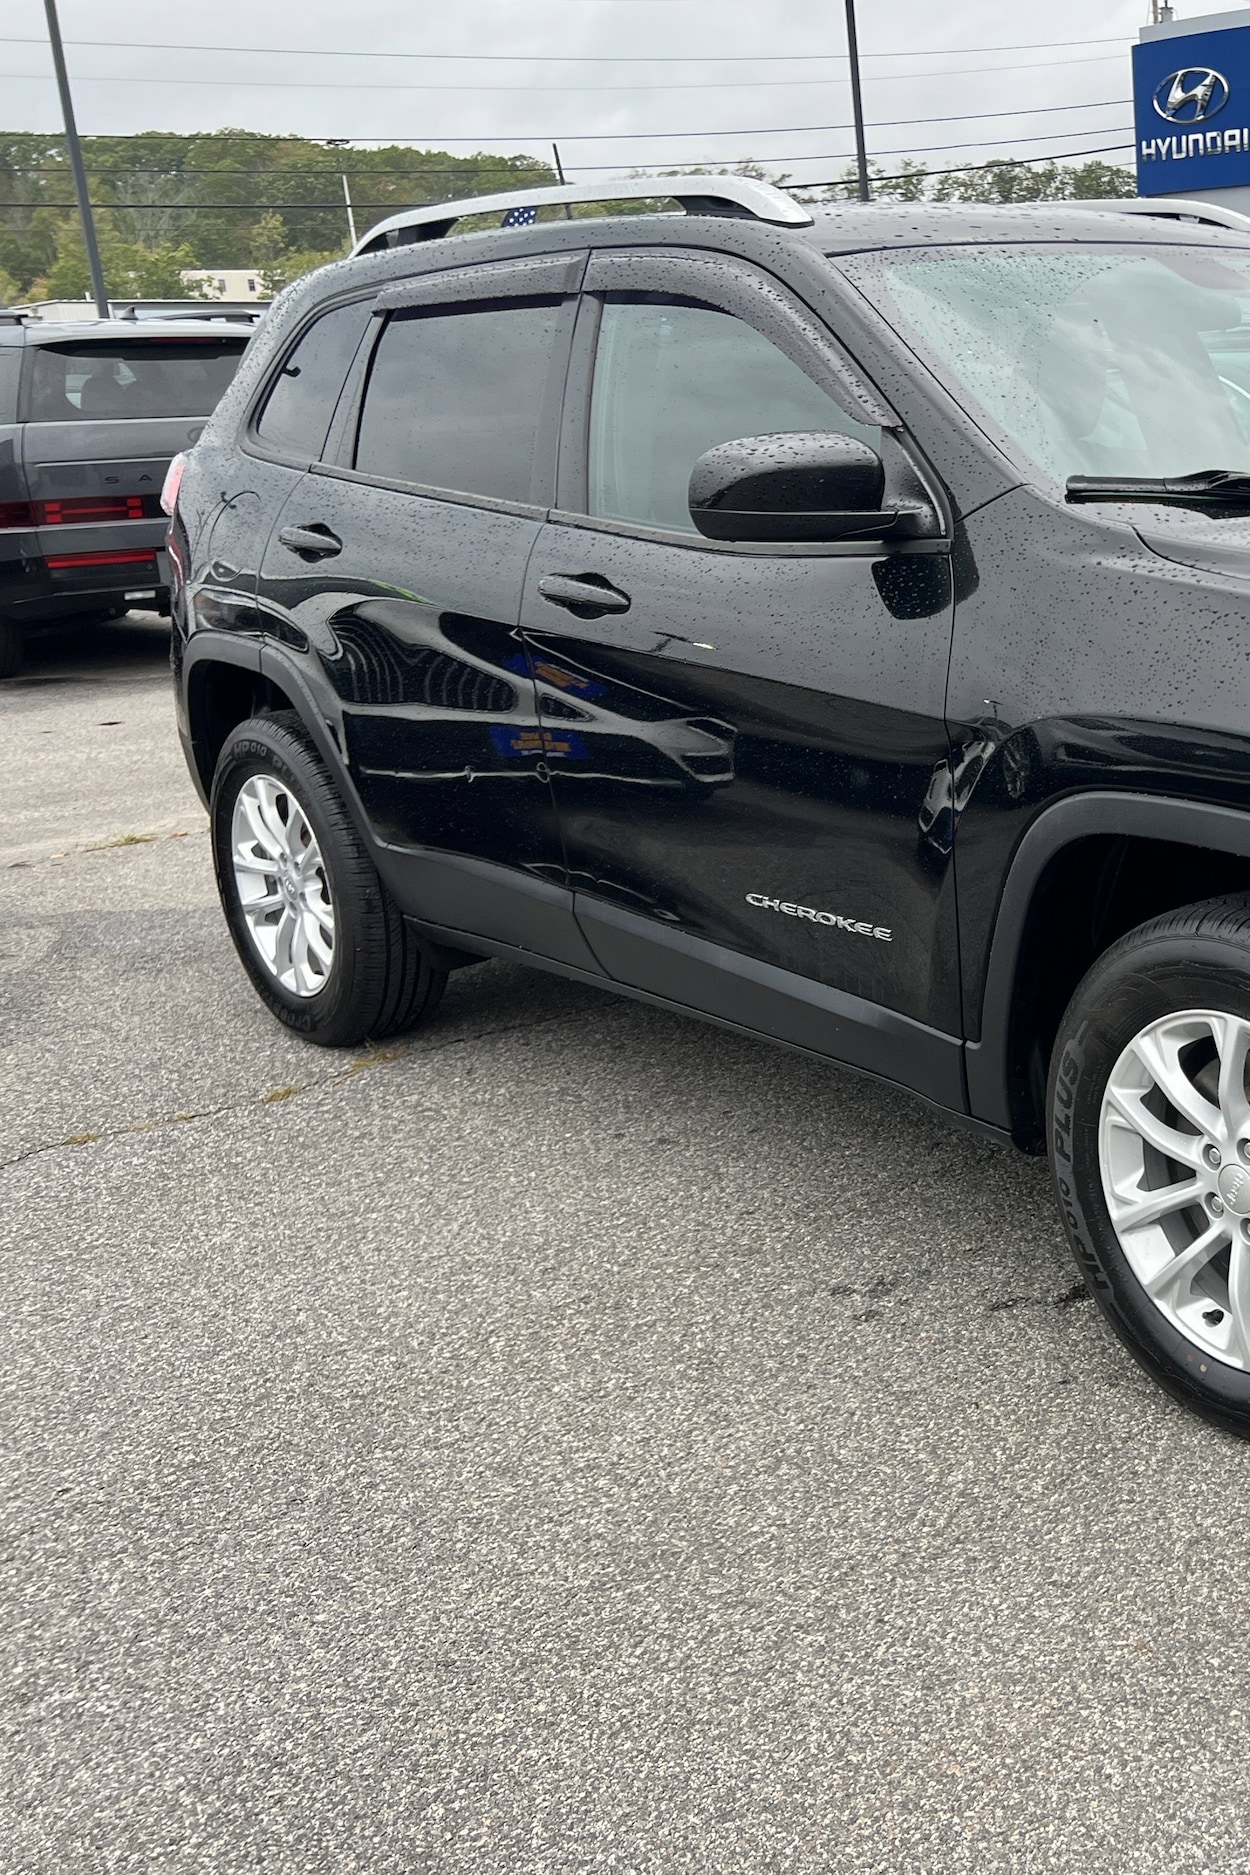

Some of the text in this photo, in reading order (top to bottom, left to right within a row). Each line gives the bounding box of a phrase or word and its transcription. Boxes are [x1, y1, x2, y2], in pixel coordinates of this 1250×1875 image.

[1141, 127, 1249, 162] HYUNDAI
[745, 893, 893, 942] CHEROKEE
[1054, 1050, 1080, 1163] PLUS
